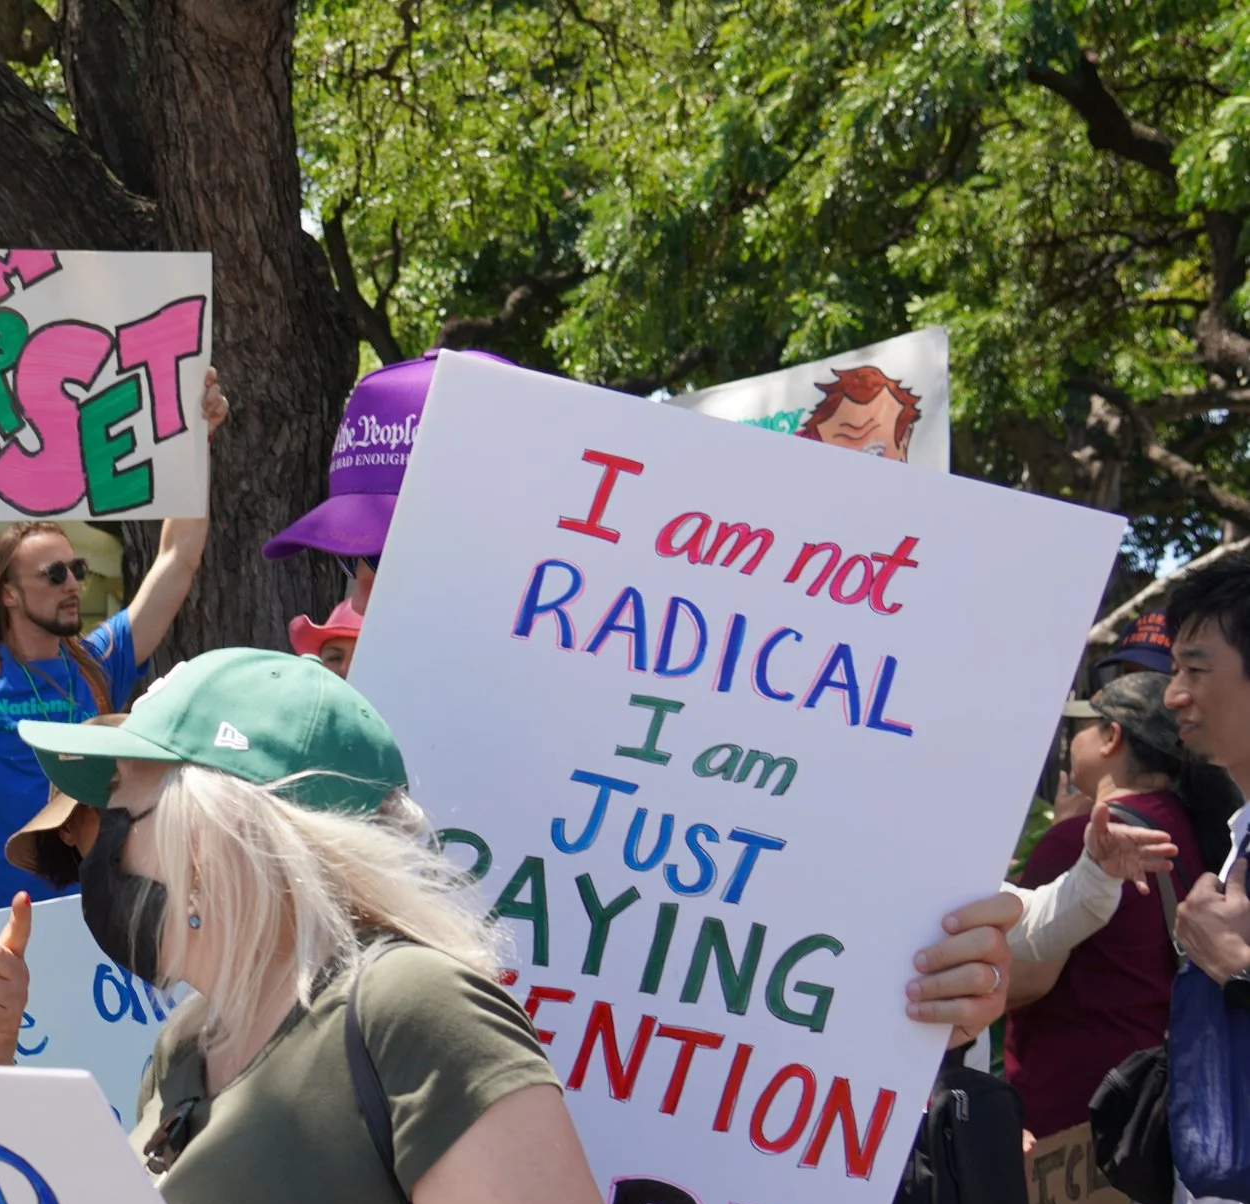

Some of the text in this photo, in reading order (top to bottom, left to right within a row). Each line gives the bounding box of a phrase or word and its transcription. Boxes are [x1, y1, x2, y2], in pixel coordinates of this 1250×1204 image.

[557, 448, 920, 615] I am not
[512, 557, 914, 738] RADICAL
[615, 693, 797, 796] I am
[550, 769, 787, 905] JUST
[492, 967, 897, 1182] ENTION
